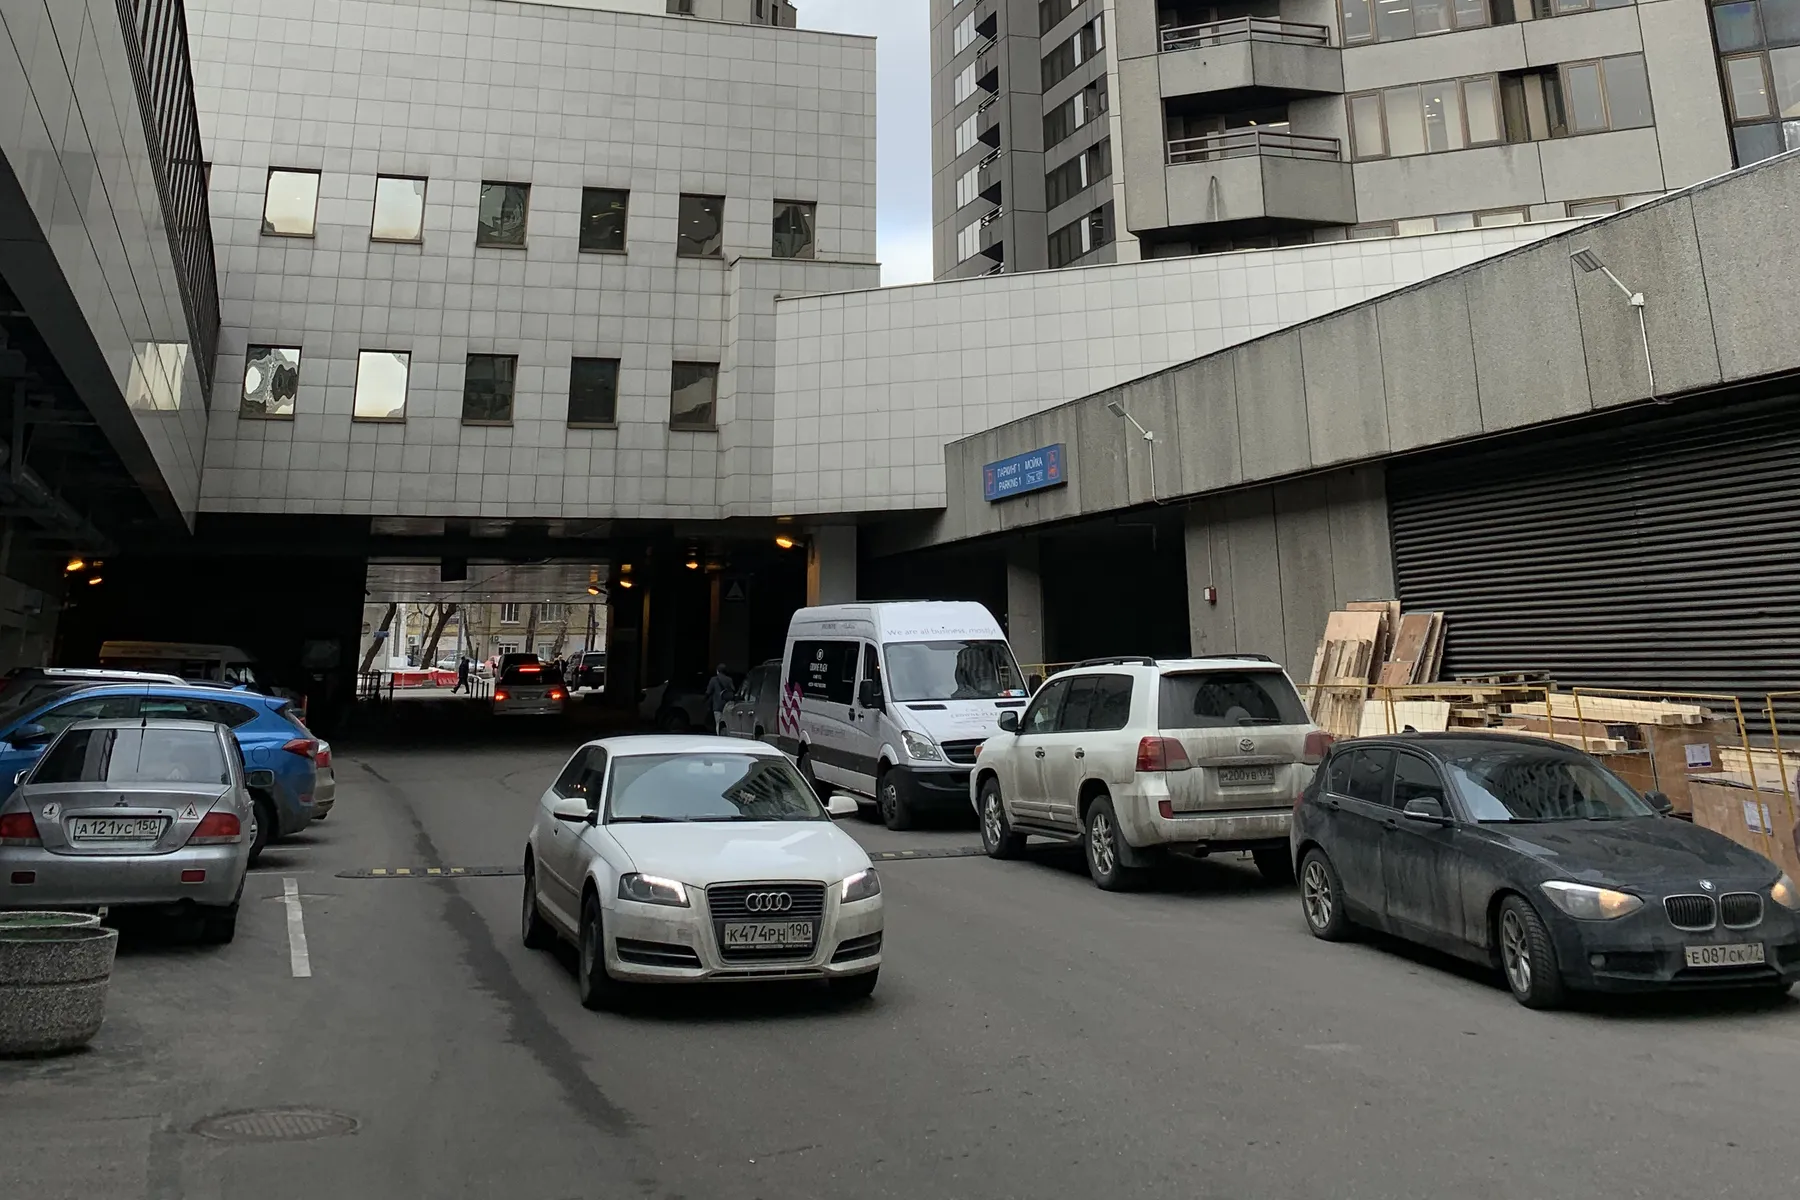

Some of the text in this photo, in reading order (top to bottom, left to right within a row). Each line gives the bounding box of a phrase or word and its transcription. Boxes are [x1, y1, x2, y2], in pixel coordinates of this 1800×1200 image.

[1024, 456, 1043, 470] МОЙКА
[998, 478, 1018, 492] PARKING
[79, 820, 156, 835] А121УС 150
[729, 923, 809, 942] К474РН 190
[1691, 946, 1745, 965] Е087СК
